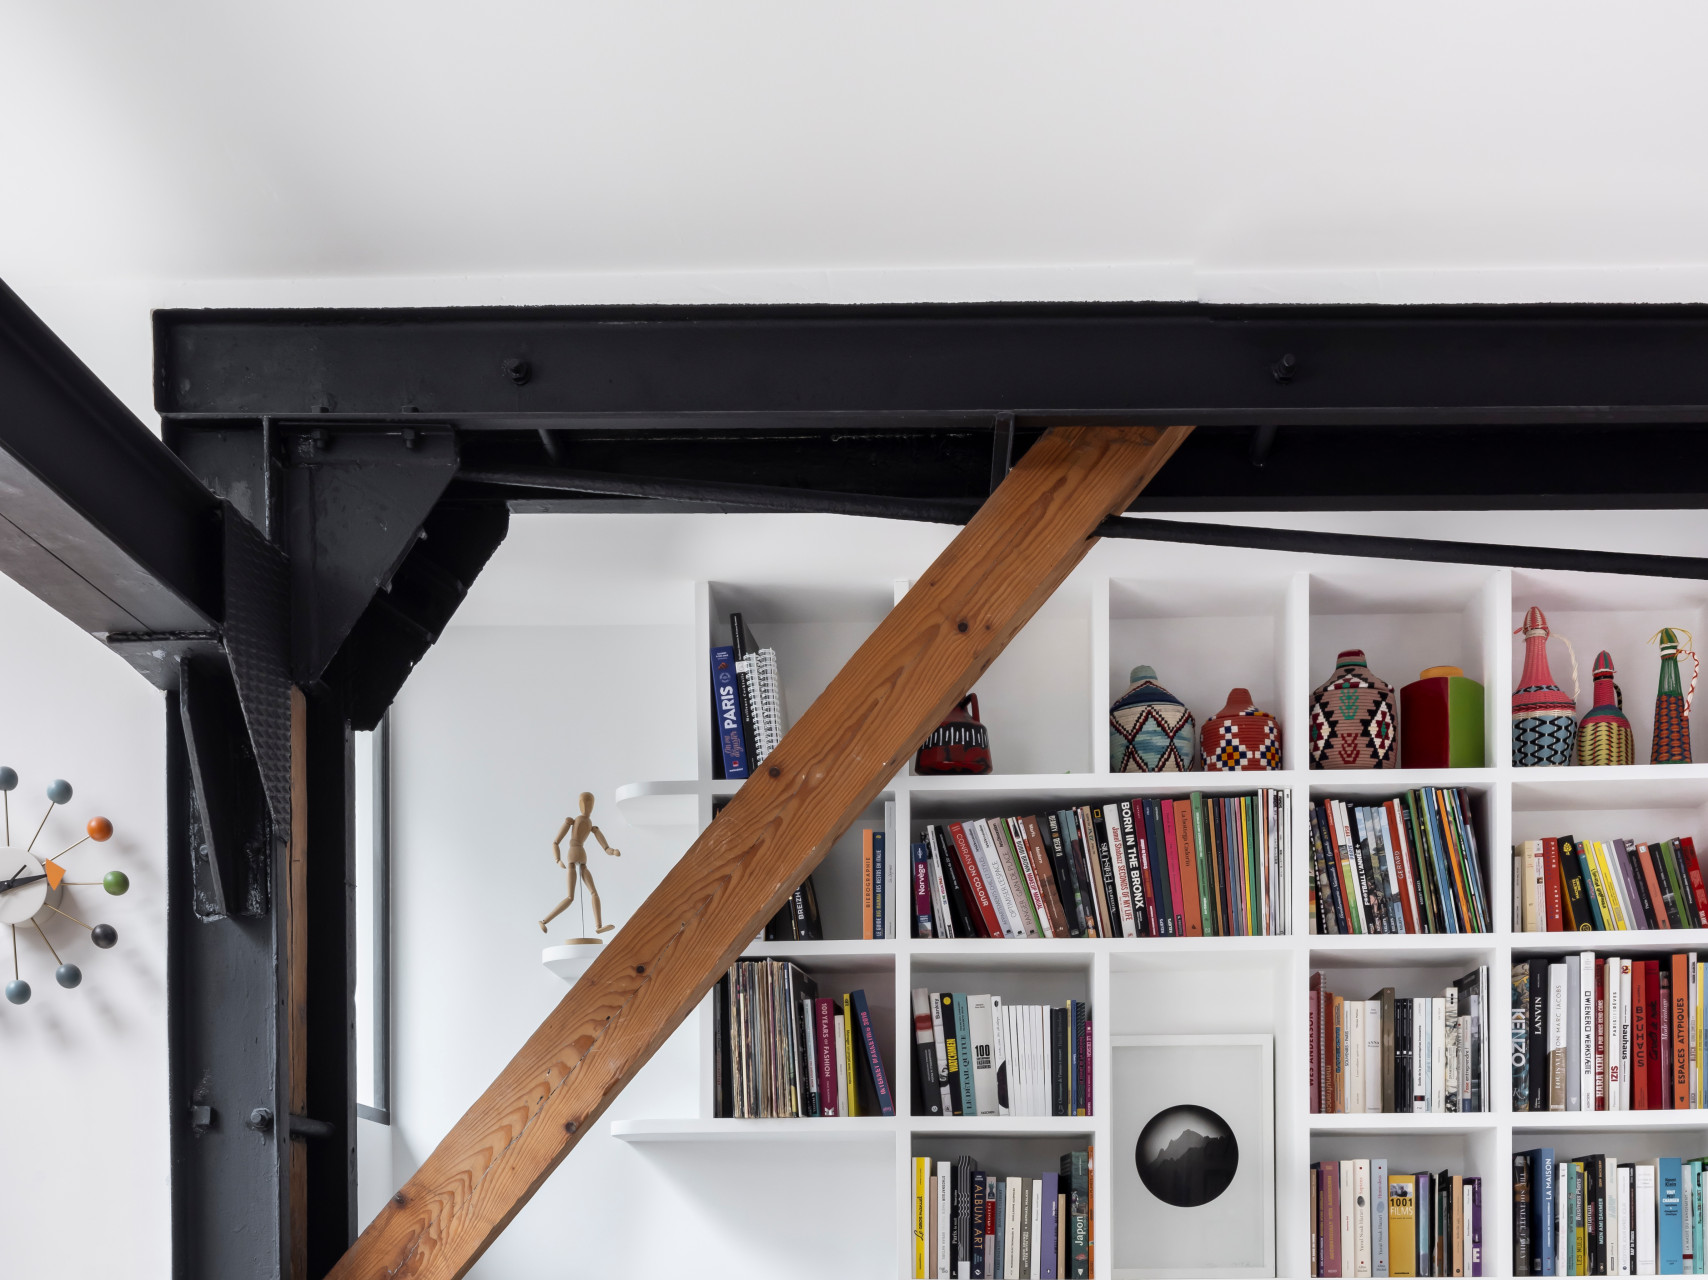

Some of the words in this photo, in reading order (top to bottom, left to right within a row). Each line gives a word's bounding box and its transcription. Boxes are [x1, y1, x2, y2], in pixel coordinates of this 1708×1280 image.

[720, 686, 738, 730] PARIS
[1121, 801, 1133, 833] BORN
[1125, 834, 1135, 846] IN
[956, 833, 972, 865] CONRAN
[968, 865, 977, 877] ON
[973, 876, 989, 907] COLOUR
[1128, 847, 1139, 869] THE
[916, 864, 926, 896] Norvège
[1131, 870, 1145, 910] BRONX
[794, 892, 805, 920] BREIZH
[822, 1015, 830, 1038] YEARS
[1534, 996, 1542, 1035] LANVIN
[1677, 998, 1685, 1045] ATYPIQUES
[865, 1026, 878, 1064] MARKETING
[975, 1044, 990, 1057] 100
[1511, 1008, 1526, 1067] KENZO
[1636, 1006, 1644, 1067] BAUHAUS
[823, 1046, 831, 1077] FASHION
[946, 1038, 958, 1073] WATCHMEN
[1596, 1054, 1604, 1073] KIRI
[1677, 1048, 1685, 1085] ESPACES
[873, 1065, 886, 1095] INTERNET
[1596, 1075, 1604, 1097] HARA
[974, 1184, 985, 1224] ALBUM
[1390, 1198, 1413, 1207] 1001
[1546, 1190, 1552, 1200] LA
[1390, 1207, 1414, 1216] FILMS
[974, 1228, 985, 1249] ART
[1074, 1216, 1085, 1246] Japon
